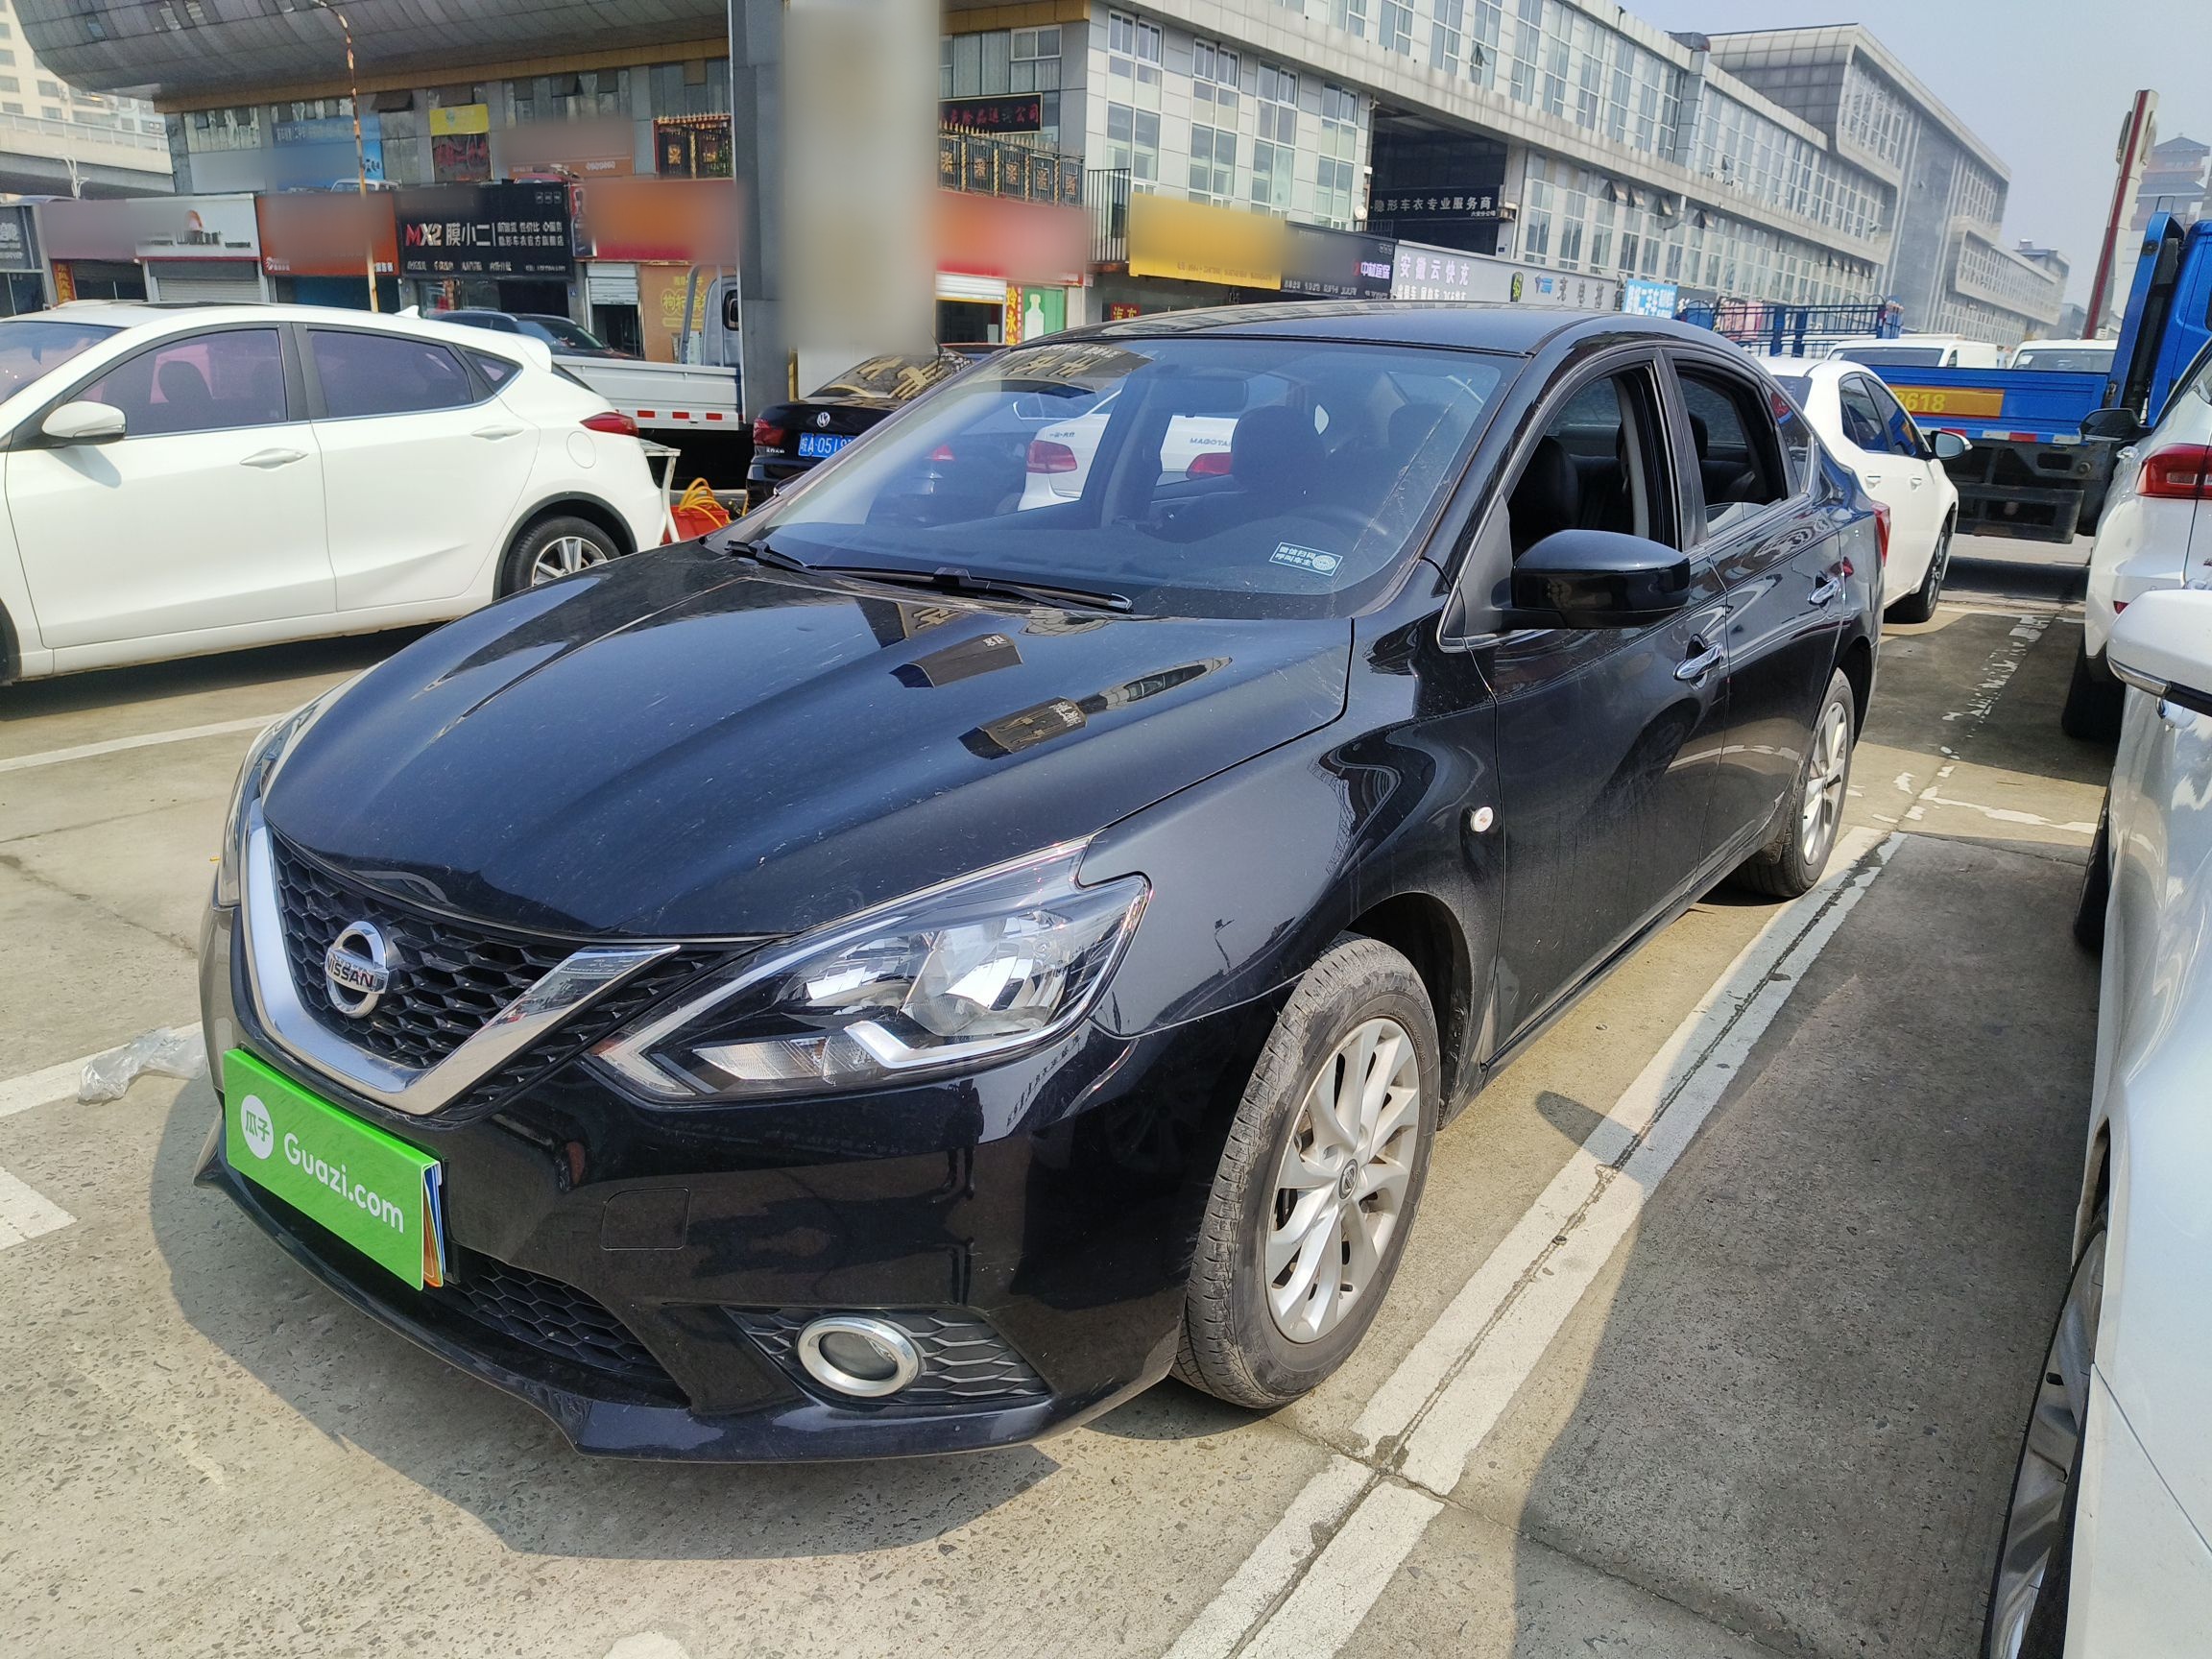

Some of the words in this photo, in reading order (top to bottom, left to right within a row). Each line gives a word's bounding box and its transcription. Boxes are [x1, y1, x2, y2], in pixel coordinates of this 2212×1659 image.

[406, 223, 443, 247] MX2
[445, 222, 491, 247] 膜小二
[1190, 438, 1232, 446] MAGOTA
[326, 954, 375, 988] NISSAN
[245, 1110, 271, 1142] 瓜子
[283, 1132, 404, 1234] Guazi.com
